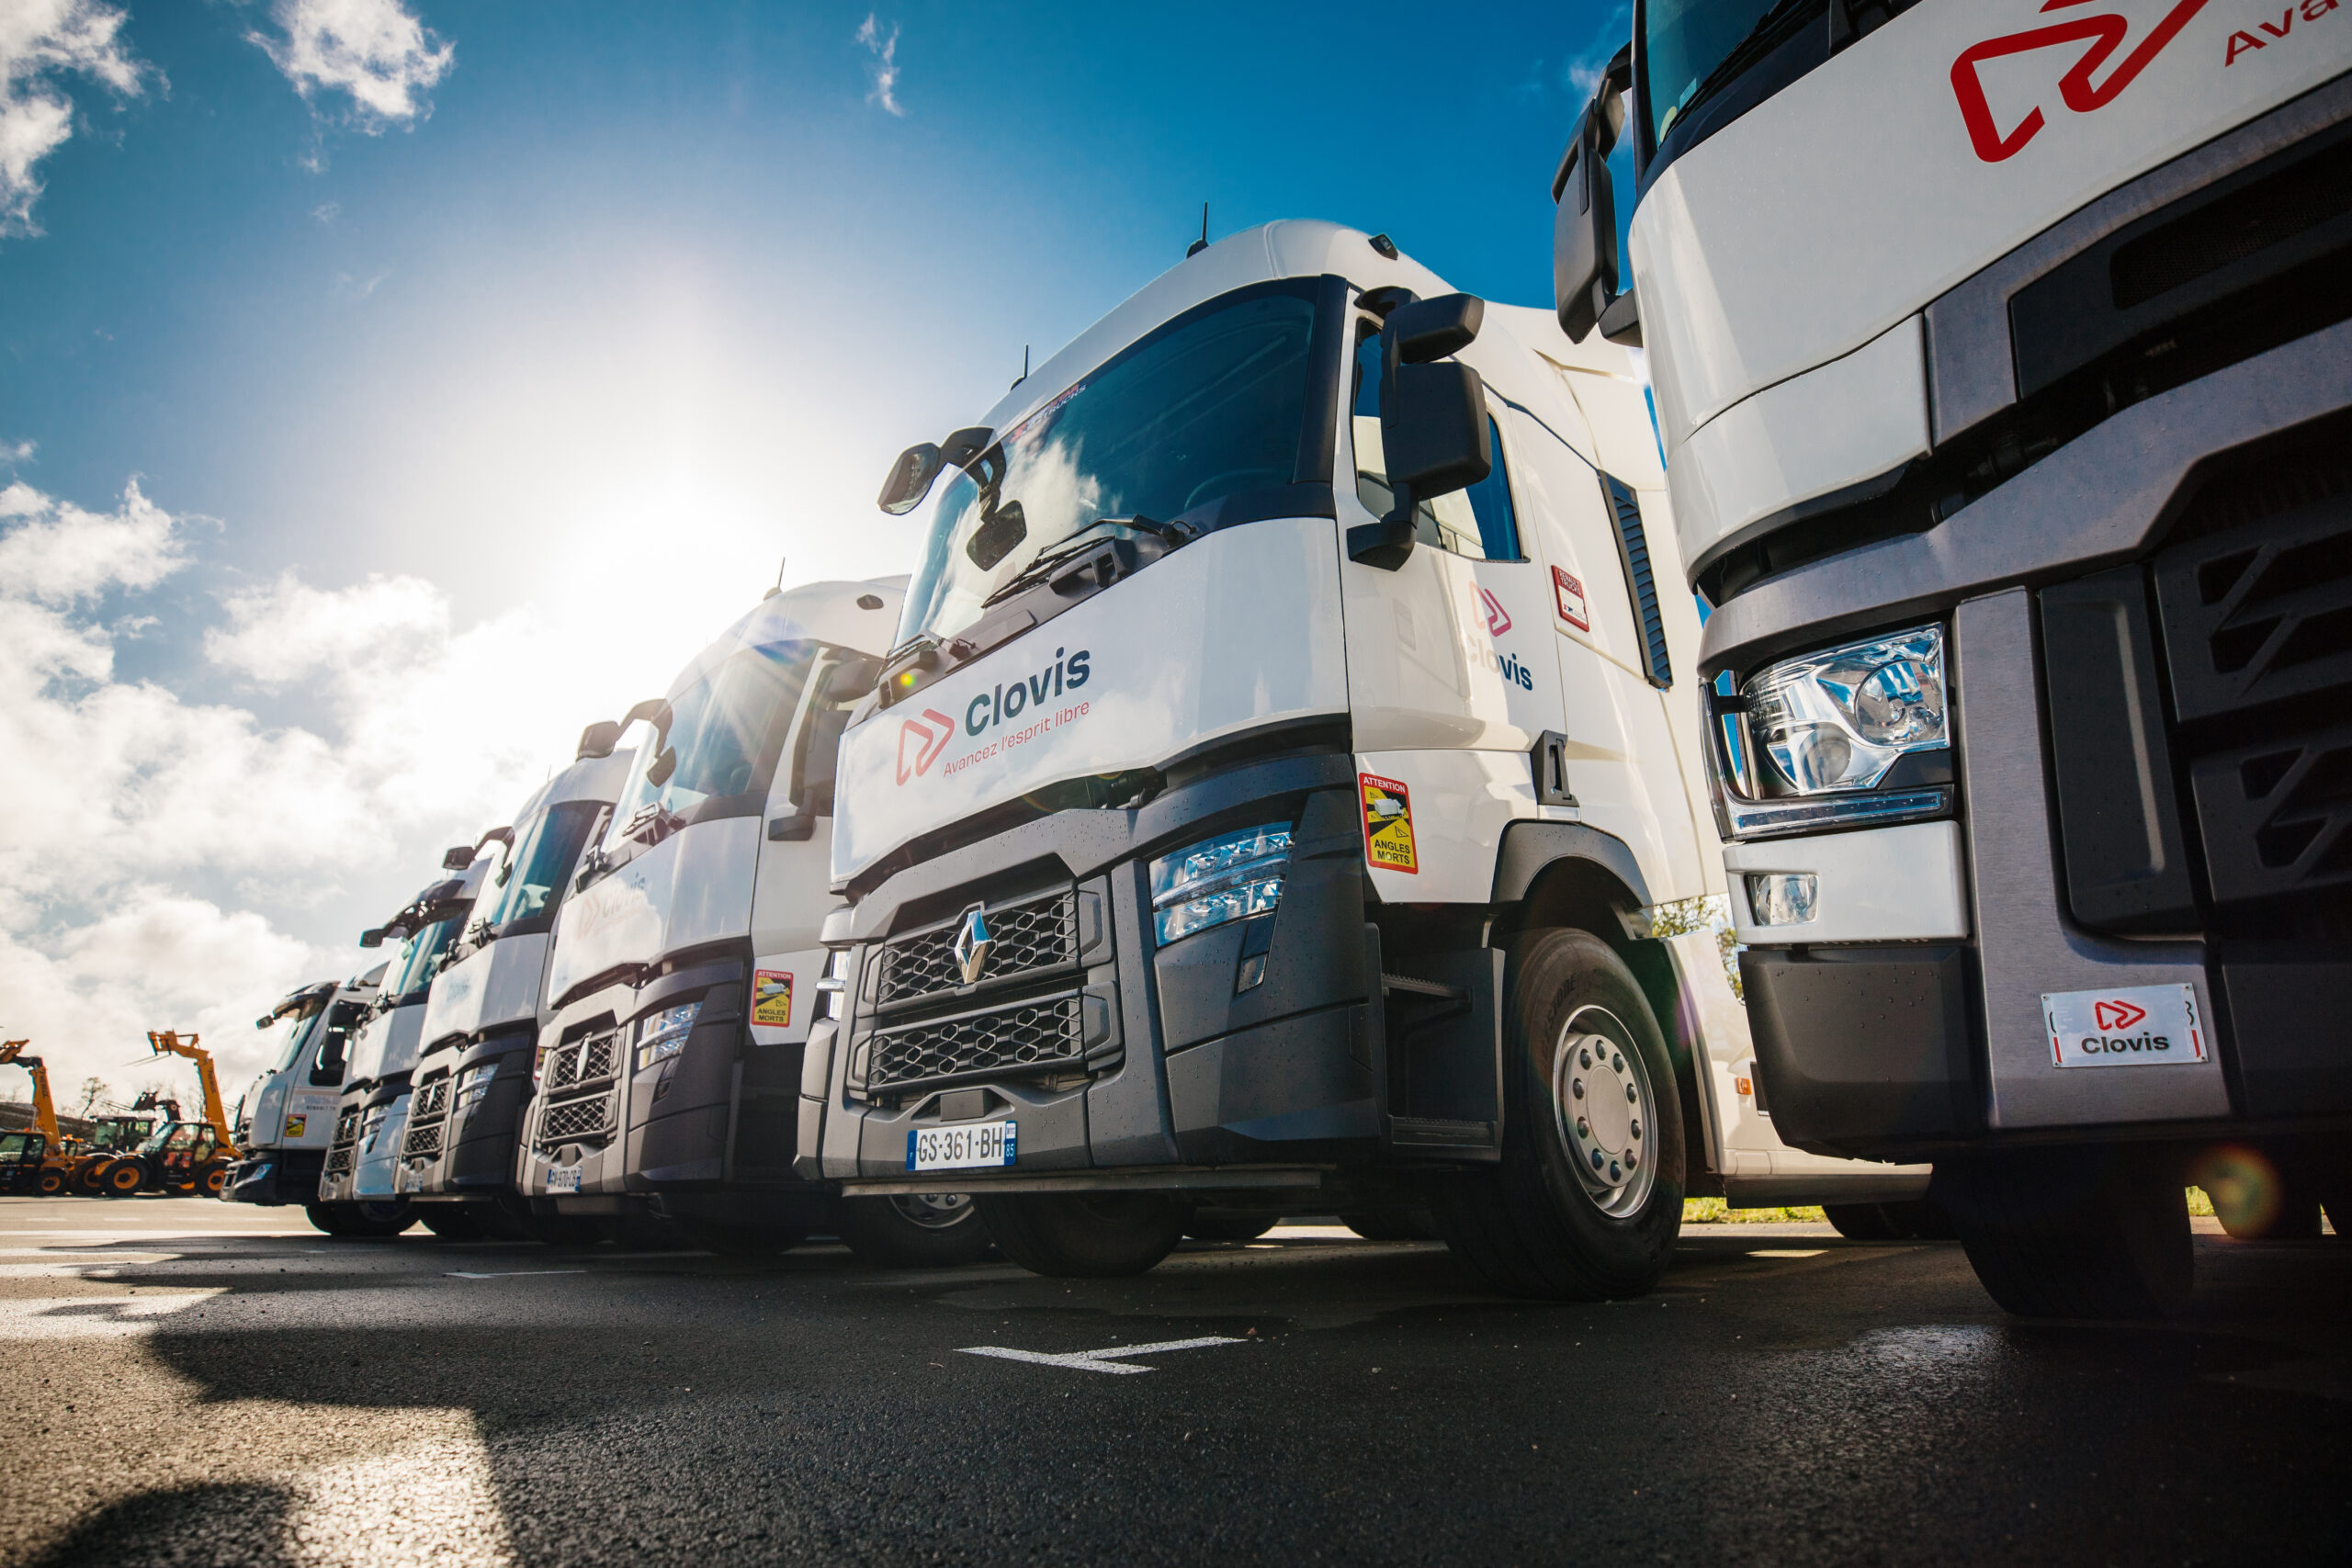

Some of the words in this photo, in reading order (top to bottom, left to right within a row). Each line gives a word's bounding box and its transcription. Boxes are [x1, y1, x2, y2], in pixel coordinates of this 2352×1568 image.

[1467, 635, 1533, 691] Clovis
[965, 646, 1091, 737] Clovis
[943, 742, 998, 778] Avancez
[1001, 716, 1051, 752] l'esprit
[1055, 700, 1090, 728] libre
[1363, 776, 1406, 793] ATTENTION
[1374, 839, 1410, 854] ANGLES
[1377, 850, 1410, 864] MORTS
[758, 971, 791, 979] ATTENTION
[757, 1008, 786, 1017] ANGLES
[758, 1014, 785, 1022] MORTS
[2081, 1031, 2170, 1055] Clovis
[1006, 1144, 1014, 1157] 85
